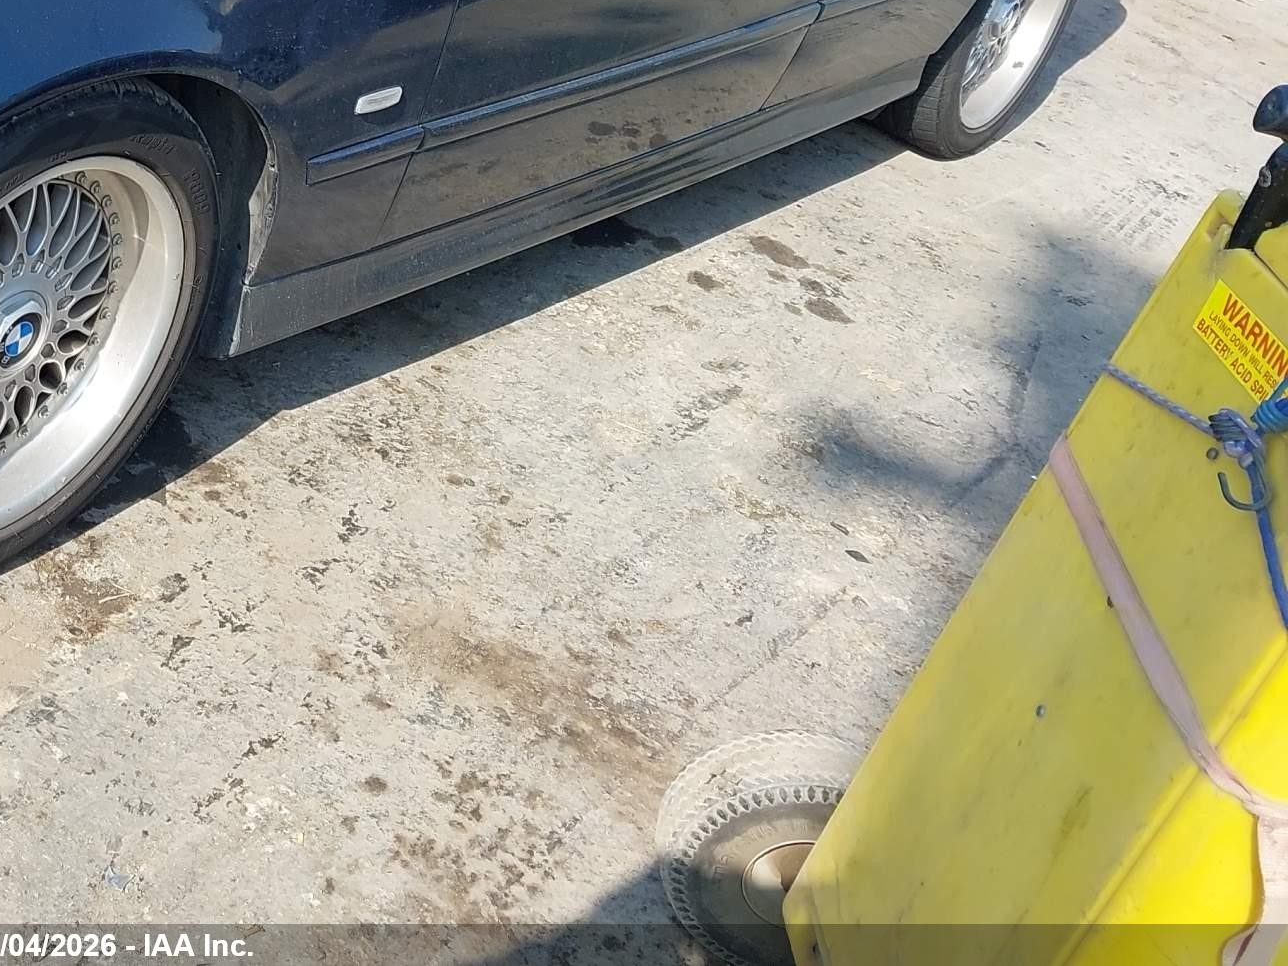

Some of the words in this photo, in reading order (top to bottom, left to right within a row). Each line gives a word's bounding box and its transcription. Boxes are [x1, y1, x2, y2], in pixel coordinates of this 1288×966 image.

[1196, 317, 1233, 361] BATTERY
[1230, 357, 1253, 384] ACID
[1209, 310, 1232, 337] LAYING
[1229, 333, 1251, 357] DOWN
[1248, 353, 1264, 375] WILL
[1222, 292, 1288, 379] WARNIN
